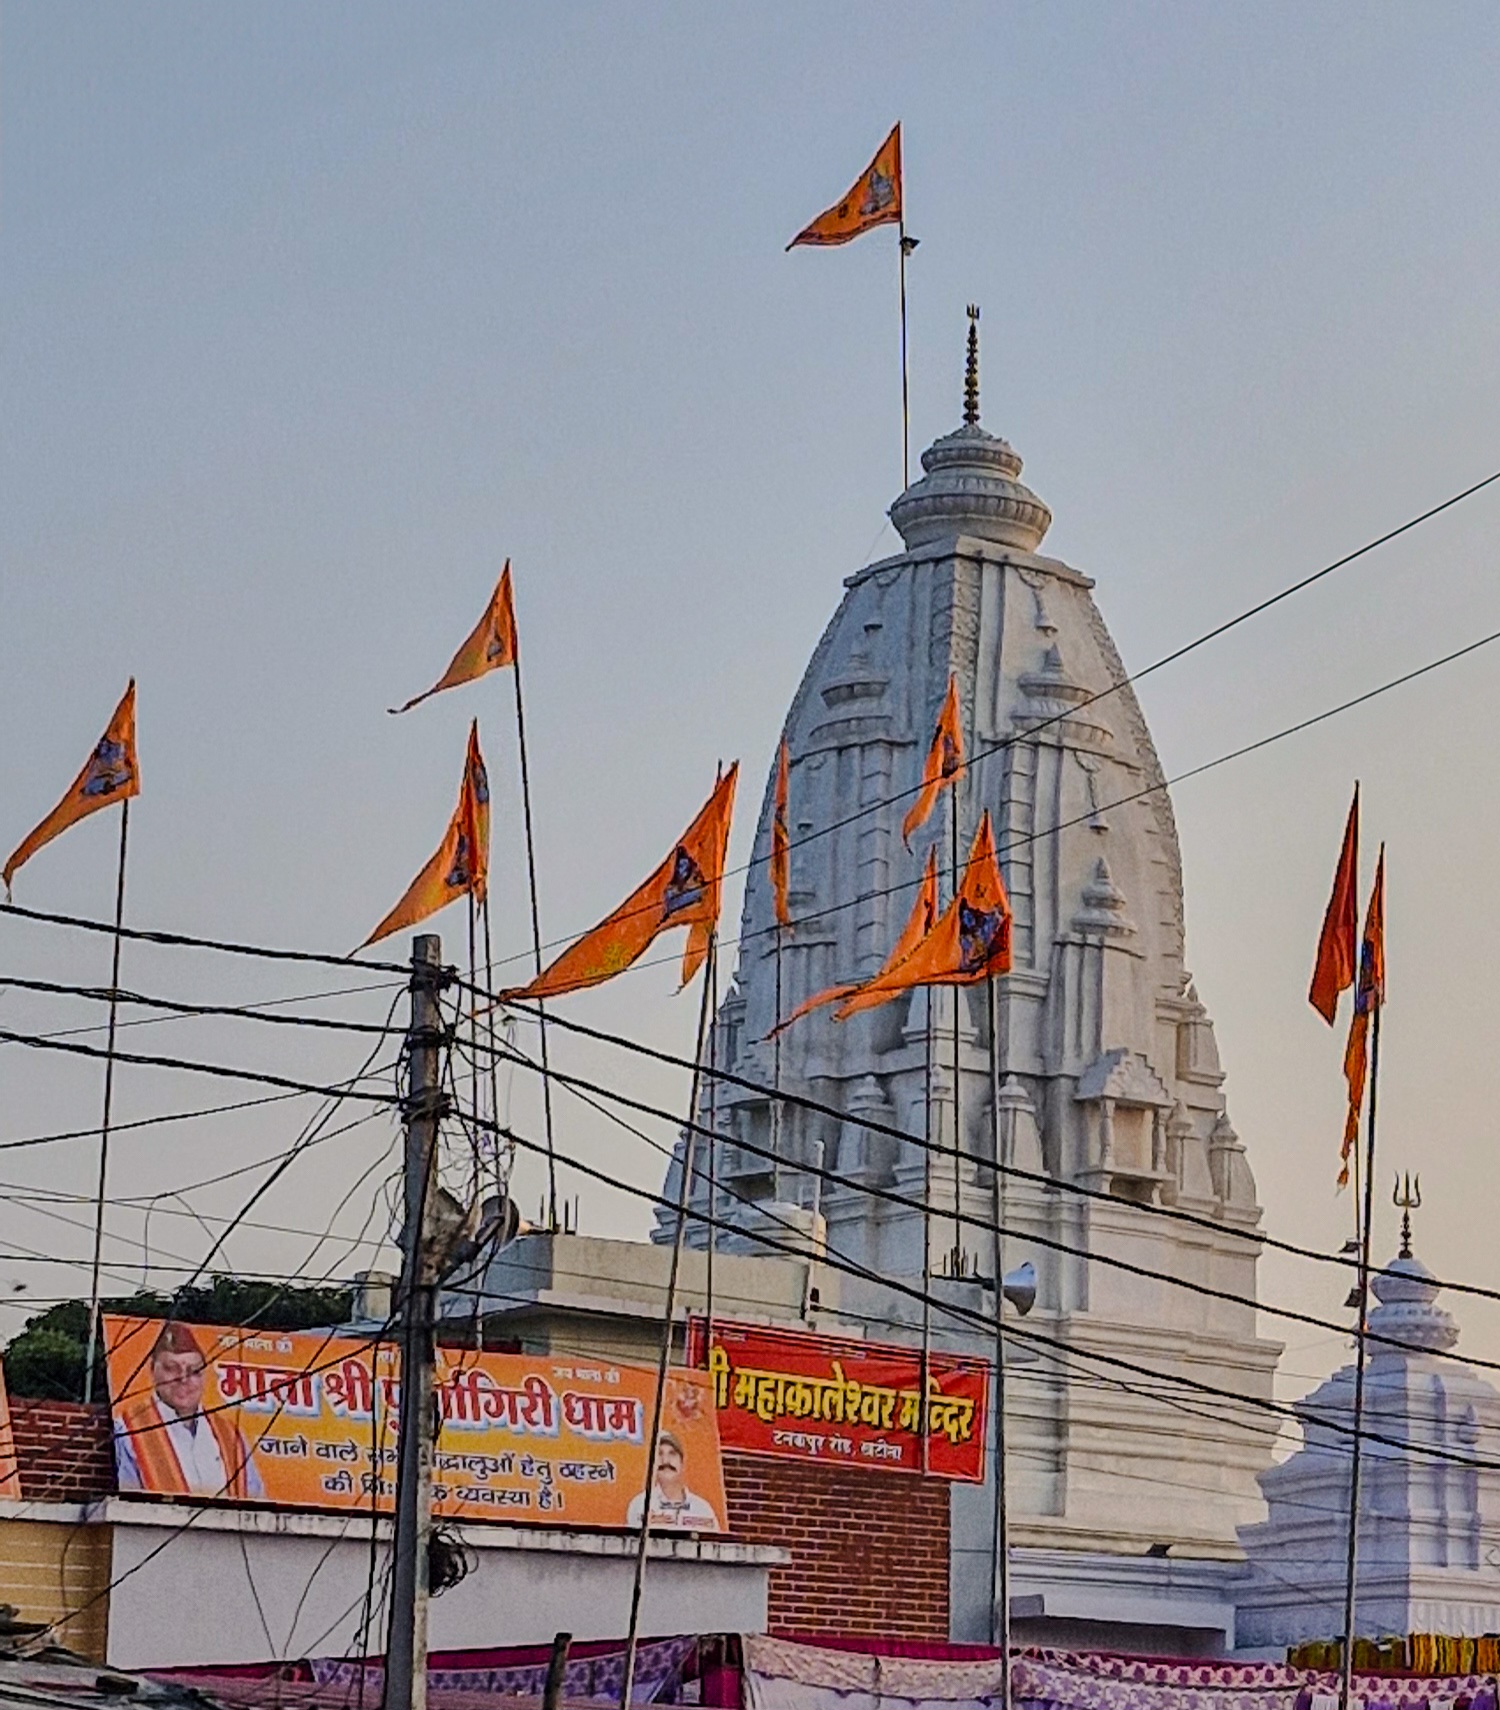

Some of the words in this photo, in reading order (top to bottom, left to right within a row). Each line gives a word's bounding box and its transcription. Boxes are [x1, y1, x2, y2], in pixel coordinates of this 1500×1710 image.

[216, 1362, 314, 1409] माता
[324, 1359, 375, 1412] श्री
[561, 1391, 638, 1435] धाम
[733, 1361, 898, 1429] महाकालेश्वर
[259, 1436, 308, 1459] जाने
[315, 1438, 358, 1462] वाले
[518, 1455, 553, 1485] हेतु
[323, 1472, 354, 1495] की
